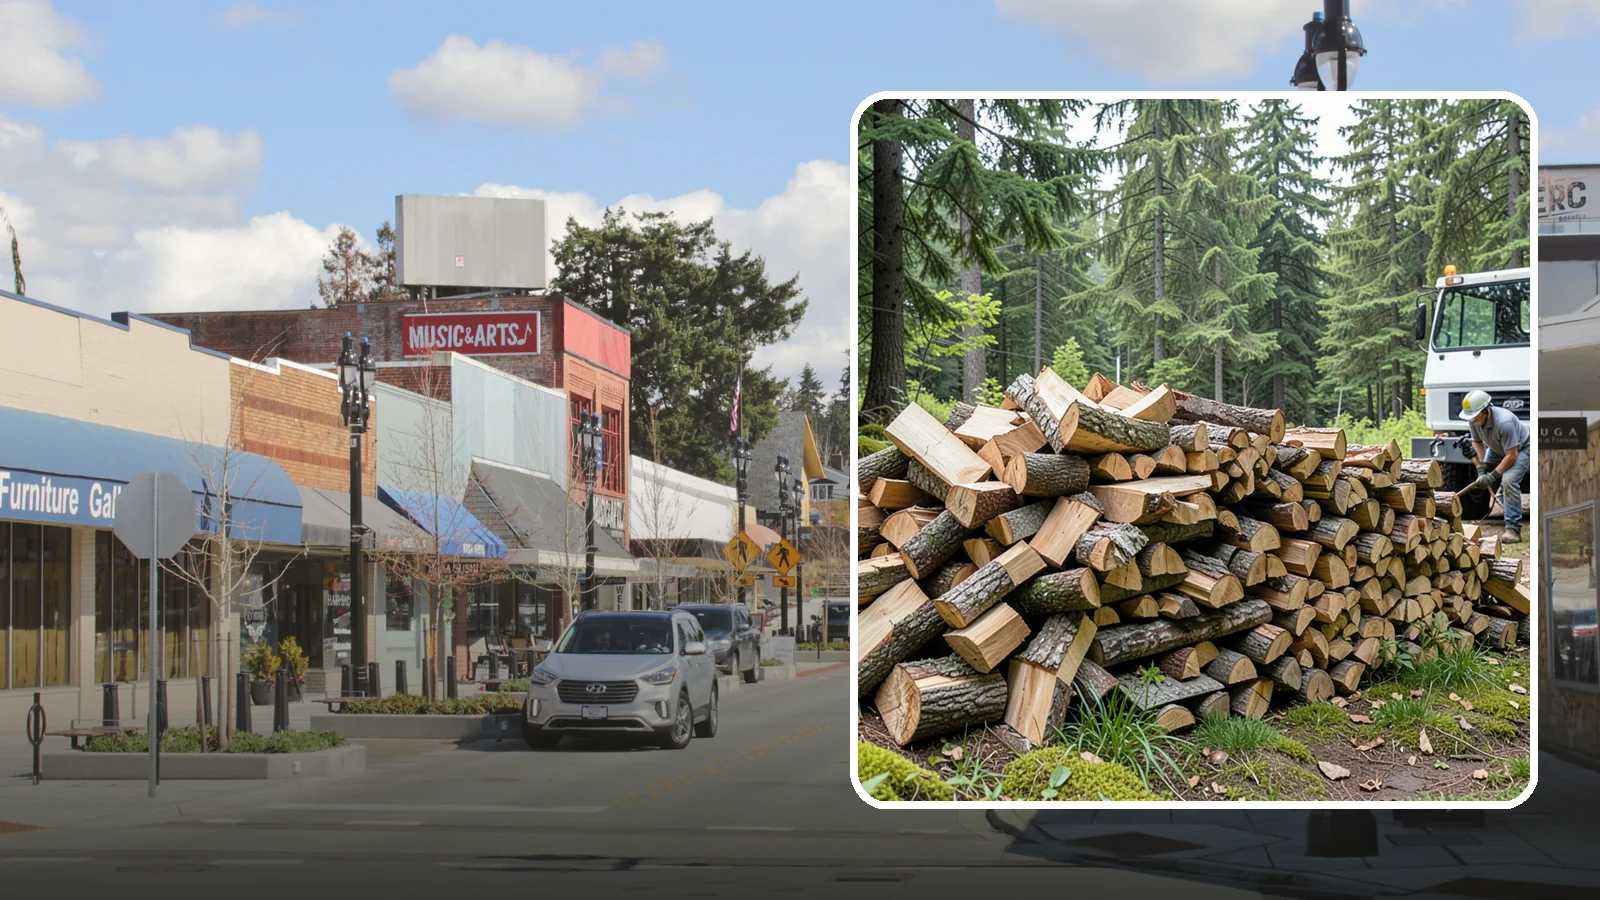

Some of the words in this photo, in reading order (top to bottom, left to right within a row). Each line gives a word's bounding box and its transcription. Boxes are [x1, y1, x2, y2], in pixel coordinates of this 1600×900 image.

[409, 323, 520, 349] MUSIC&ARTS
[1540, 427, 1577, 437] UGA
[0, 471, 79, 515] Furniture
[453, 562, 480, 575] SUSHI
